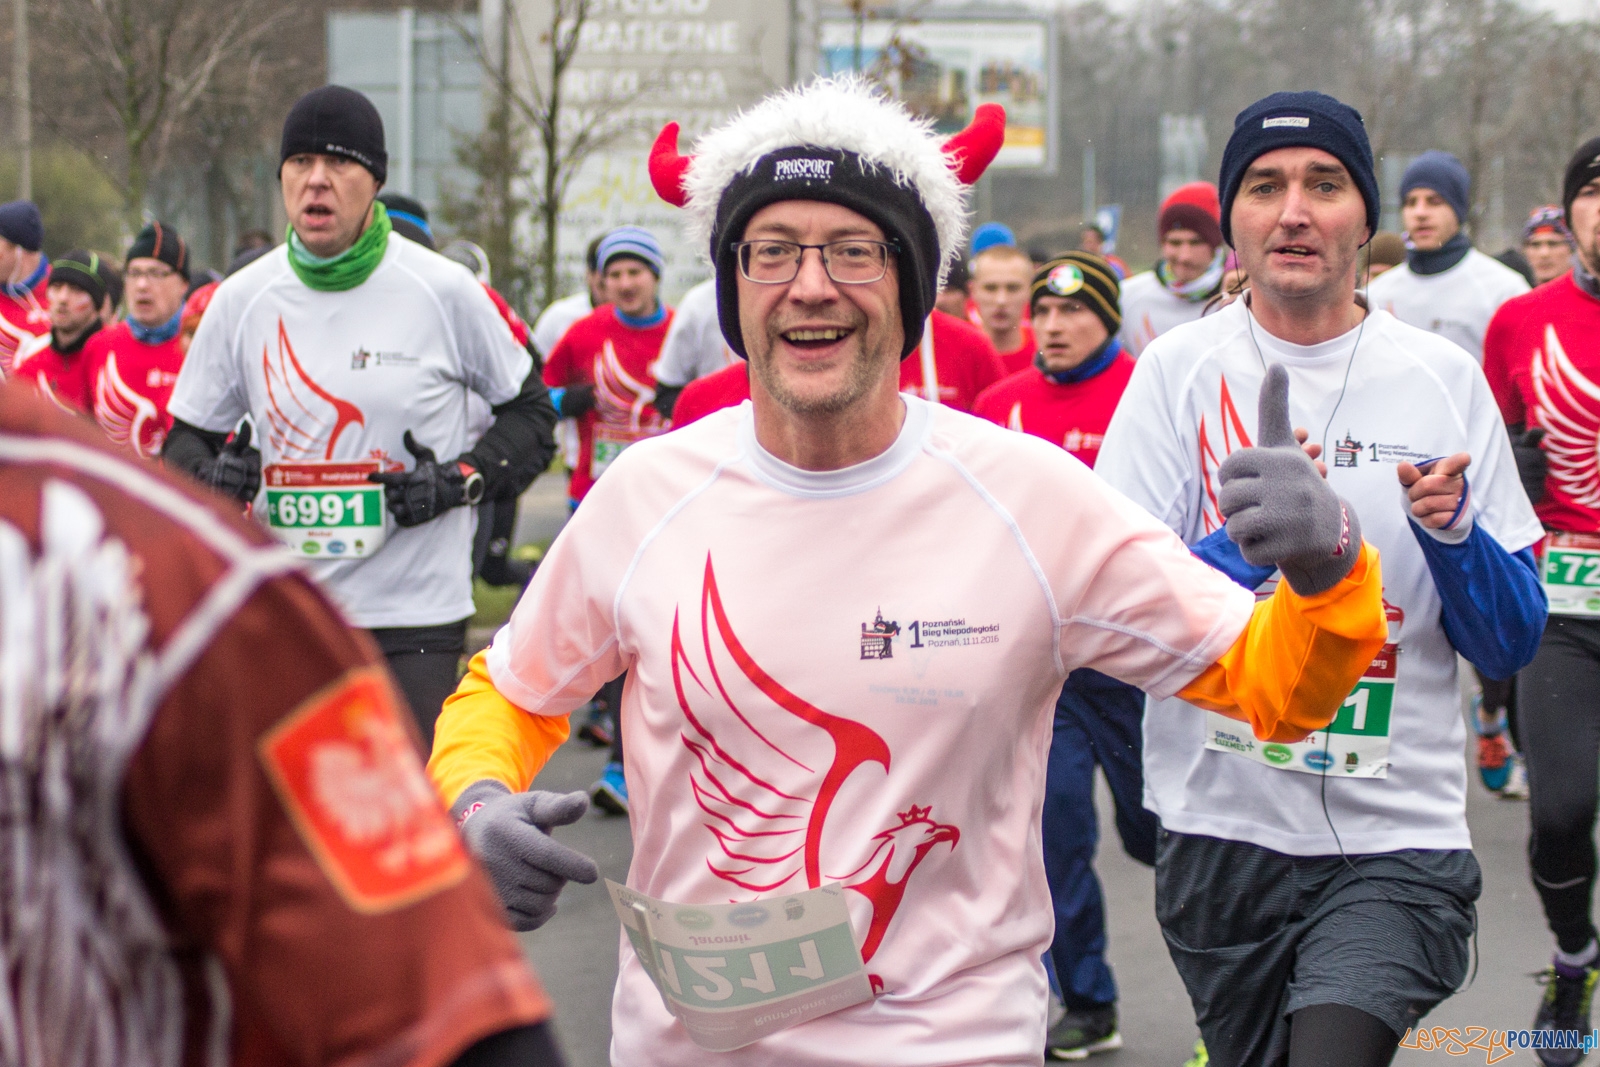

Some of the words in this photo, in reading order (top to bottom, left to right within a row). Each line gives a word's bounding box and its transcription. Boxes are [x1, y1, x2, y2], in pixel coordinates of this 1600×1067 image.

[775, 158, 834, 175] PROSPORT
[278, 492, 365, 526] 6991
[1561, 555, 1600, 585] 72
[908, 620, 925, 649] 1
[922, 618, 966, 628] Poznański
[922, 628, 941, 637] Bieg
[943, 623, 1000, 636] Niepodległości
[1340, 687, 1370, 731] 1
[1215, 730, 1241, 744] GRUPA
